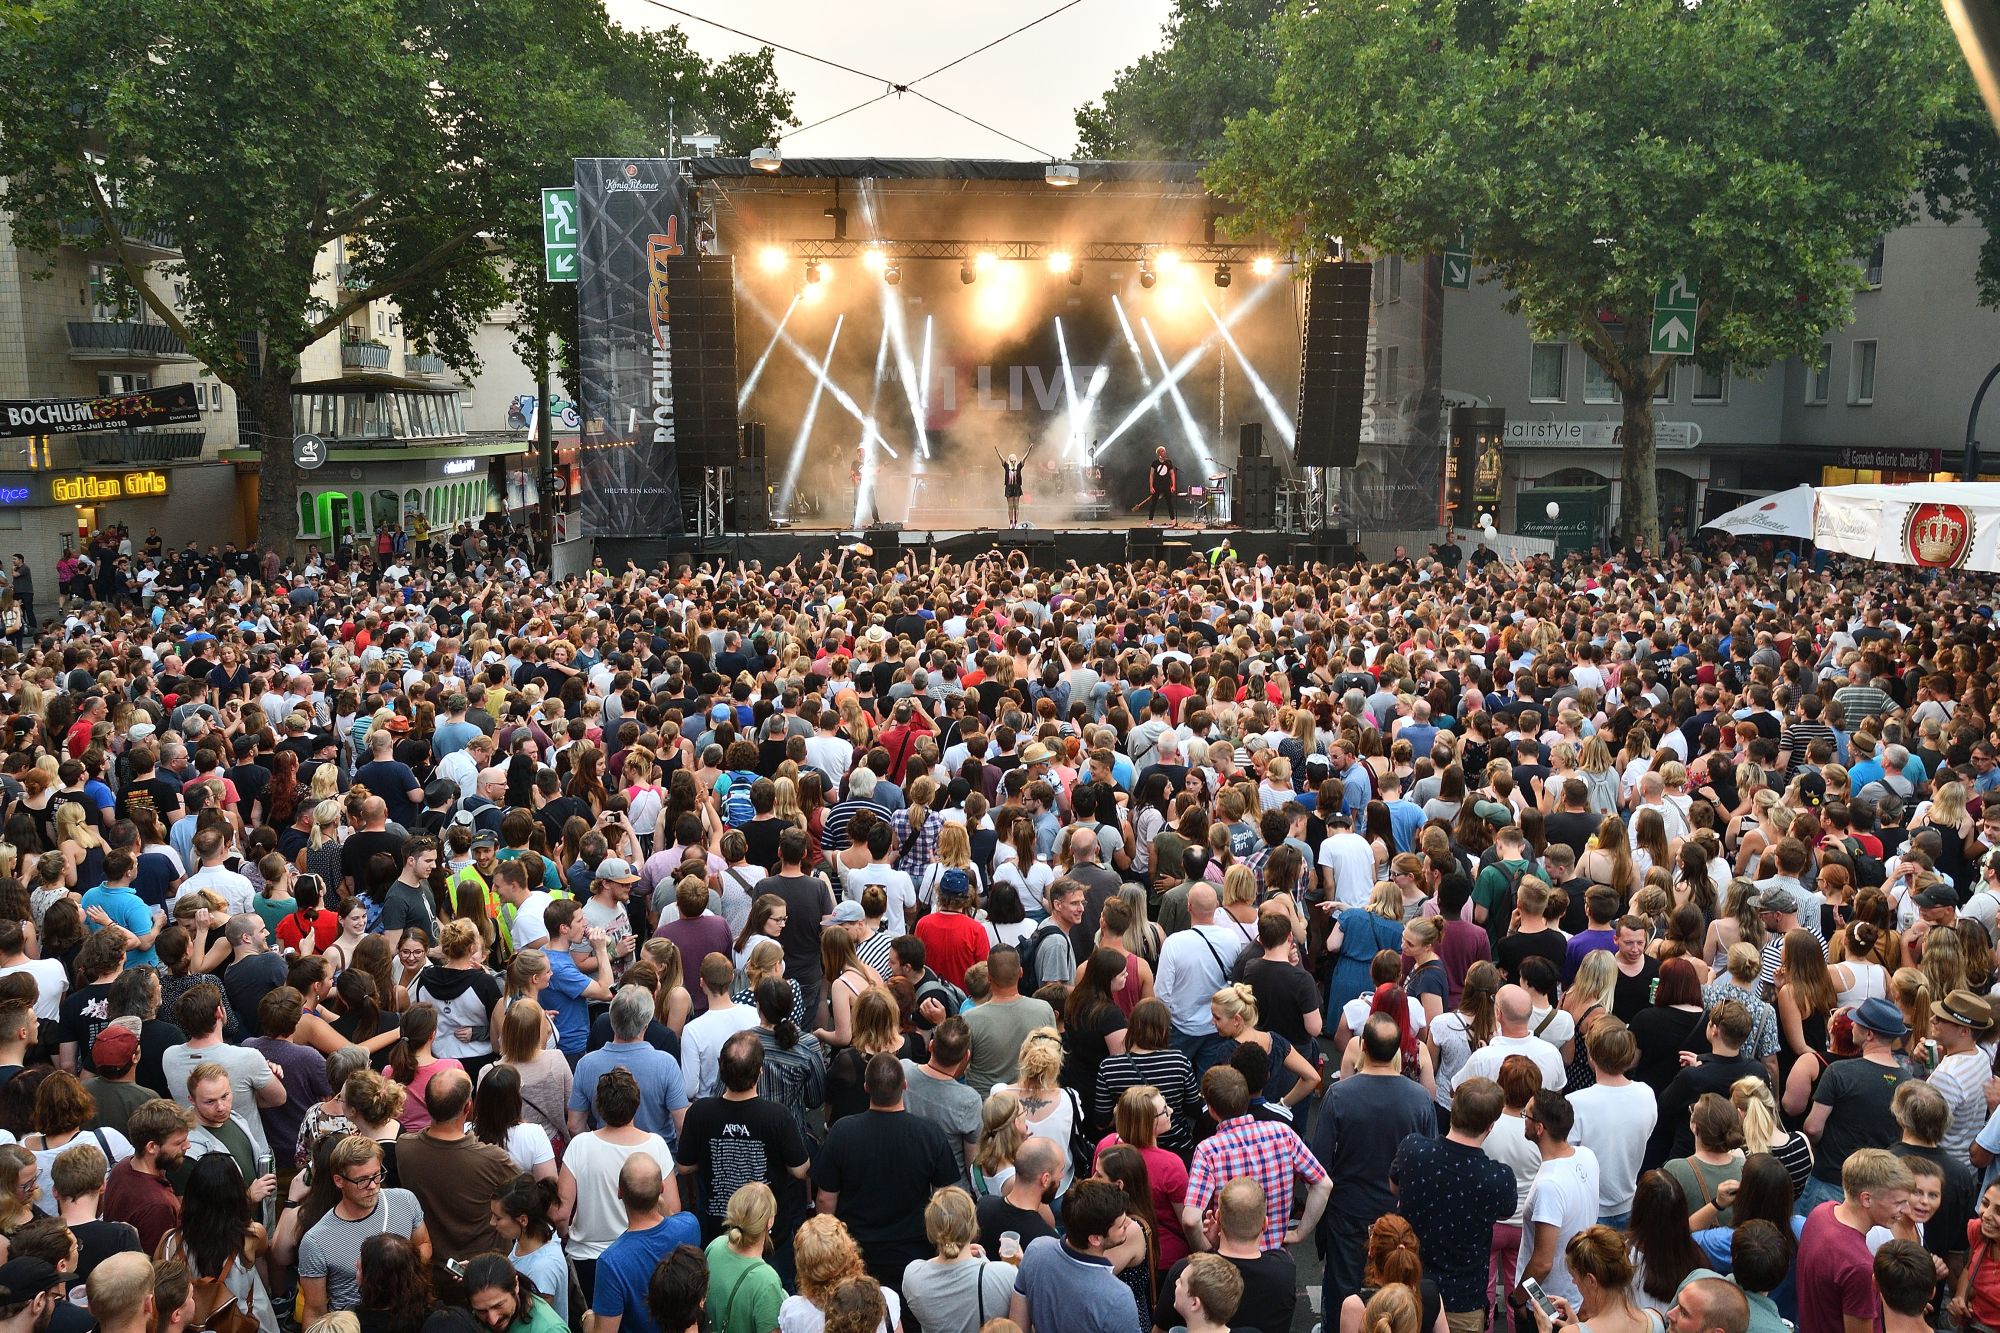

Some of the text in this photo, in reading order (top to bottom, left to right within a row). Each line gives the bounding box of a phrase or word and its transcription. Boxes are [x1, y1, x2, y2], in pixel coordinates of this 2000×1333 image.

[605, 178, 658, 191] König Pilsener
[7, 404, 94, 426] BOCHUM
[105, 420, 128, 428] 2018
[53, 472, 166, 500] Golden Girls
[1233, 830, 1253, 843] Simple
[722, 1124, 751, 1137] ARENA
